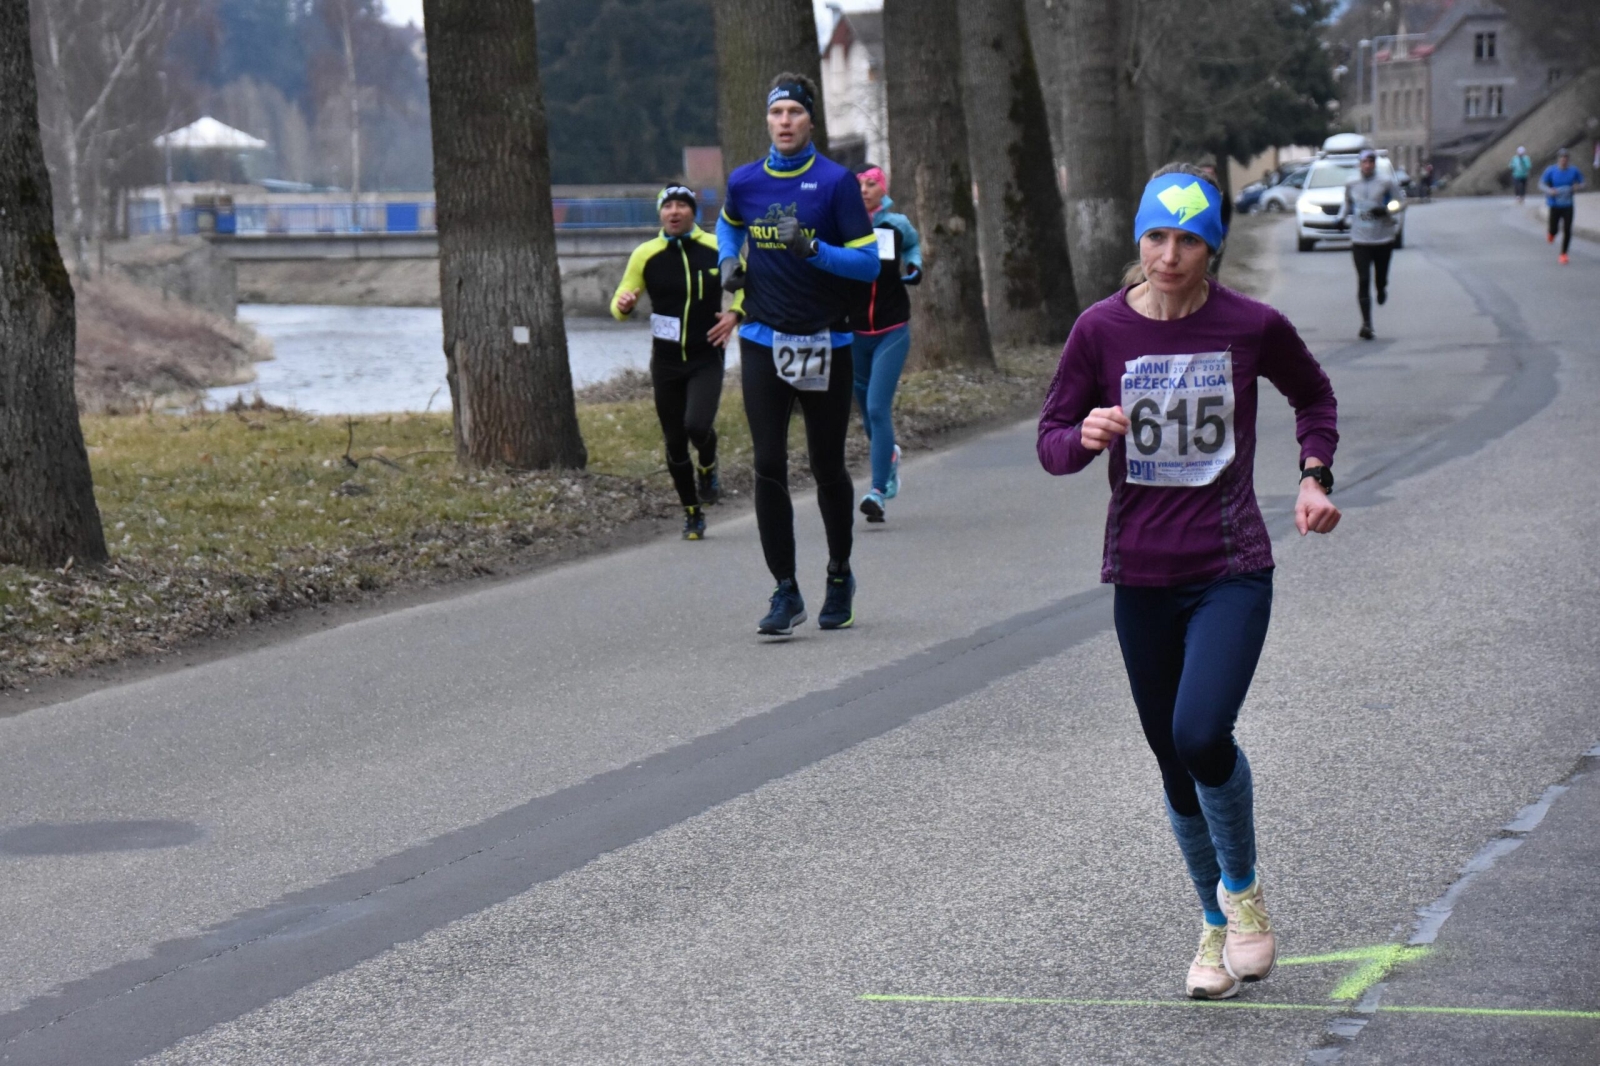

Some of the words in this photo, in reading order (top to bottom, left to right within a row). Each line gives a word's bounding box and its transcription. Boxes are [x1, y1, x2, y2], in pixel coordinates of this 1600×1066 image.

[778, 345, 827, 378] 271
[1124, 375, 1188, 390] BĚŽECKÁ
[1193, 374, 1227, 388] LIGA
[1130, 395, 1226, 456] 615
